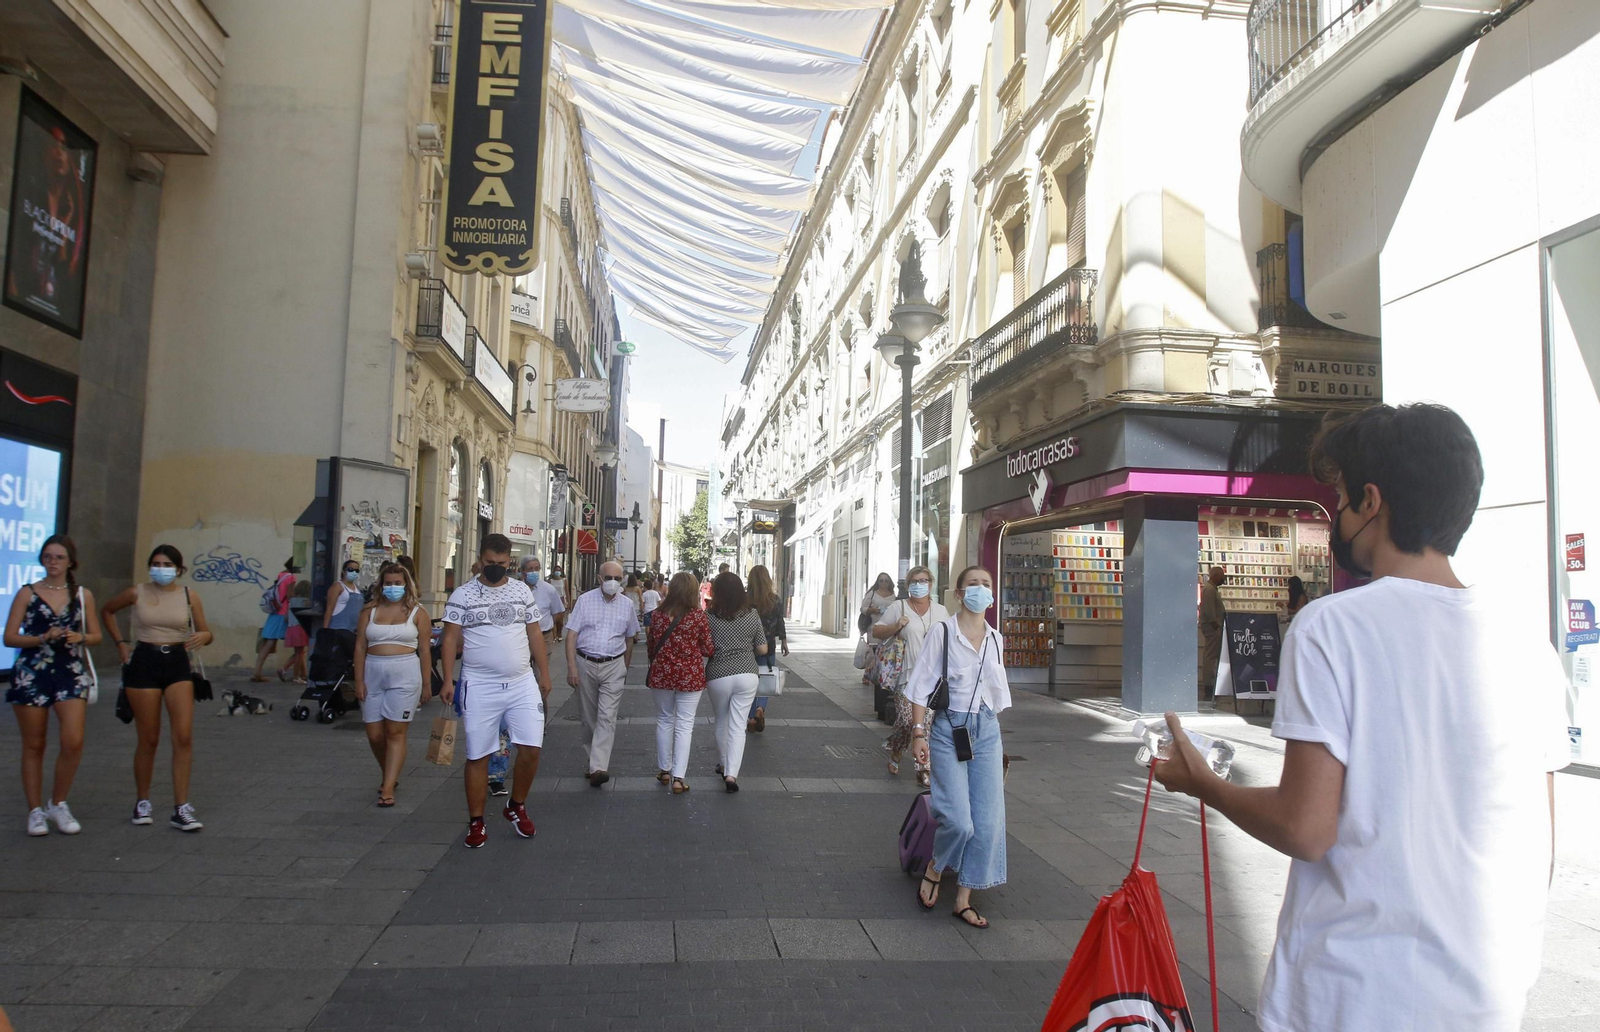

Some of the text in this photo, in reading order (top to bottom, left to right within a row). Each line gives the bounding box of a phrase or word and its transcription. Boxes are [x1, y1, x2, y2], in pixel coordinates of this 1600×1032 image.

[467, 12, 523, 208] EMFISA
[453, 217, 527, 231] PROMOTORA
[452, 231, 526, 245] INMOBILIARIA
[1293, 361, 1376, 376] MARQUES
[1298, 381, 1373, 397] DE BOIL
[1006, 437, 1074, 478] todocarcasas
[0, 473, 48, 511] SUM
[755, 514, 774, 522] Ulloa
[0, 518, 45, 553] MER
[1566, 538, 1584, 551] SALES
[1570, 612, 1586, 620] LAB
[1570, 621, 1590, 630] CLUB
[1233, 628, 1257, 643] Vuelta
[1567, 633, 1598, 643] REGISTRATI
[1235, 642, 1257, 656] al Cole
